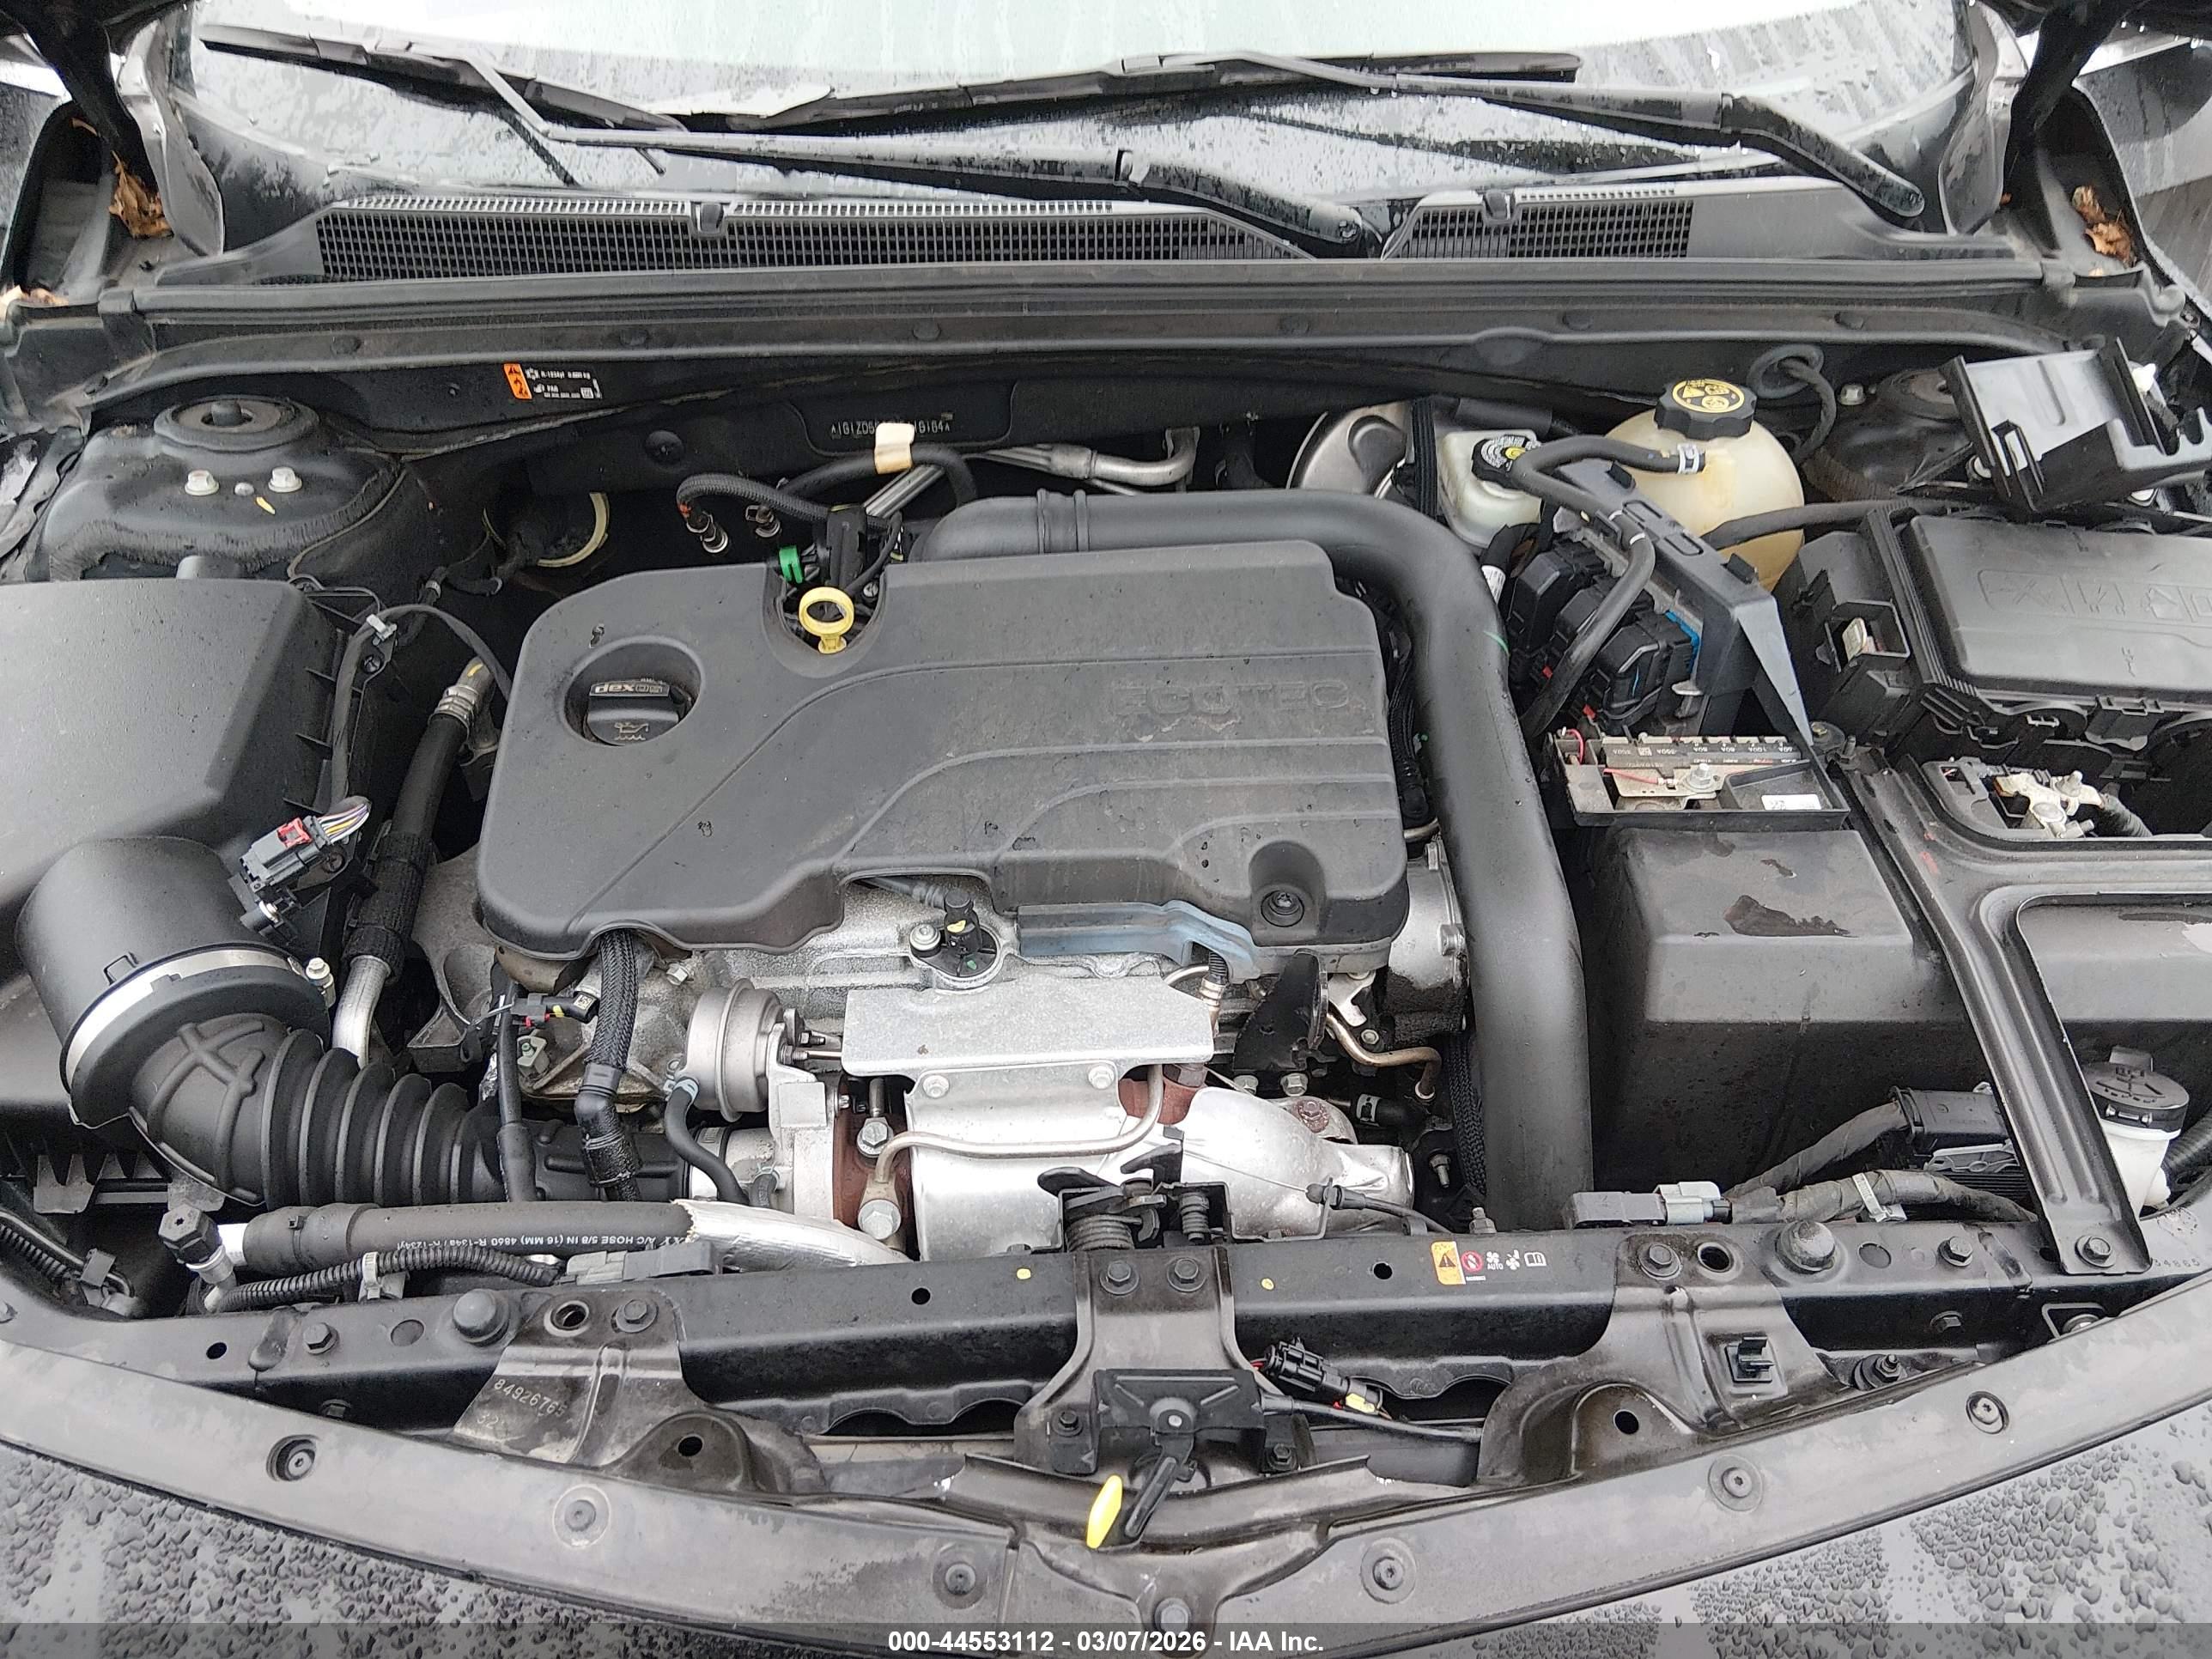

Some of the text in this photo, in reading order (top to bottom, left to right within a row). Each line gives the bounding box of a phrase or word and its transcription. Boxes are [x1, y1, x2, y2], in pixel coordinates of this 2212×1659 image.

[1112, 679, 1351, 715] ECOTEC
[520, 1234, 544, 1246] MM)
[547, 1234, 564, 1247] (16
[567, 1236, 579, 1244] IN
[581, 1236, 599, 1244] 5/8
[601, 1236, 634, 1244] HOSE
[637, 1237, 656, 1245] A/C
